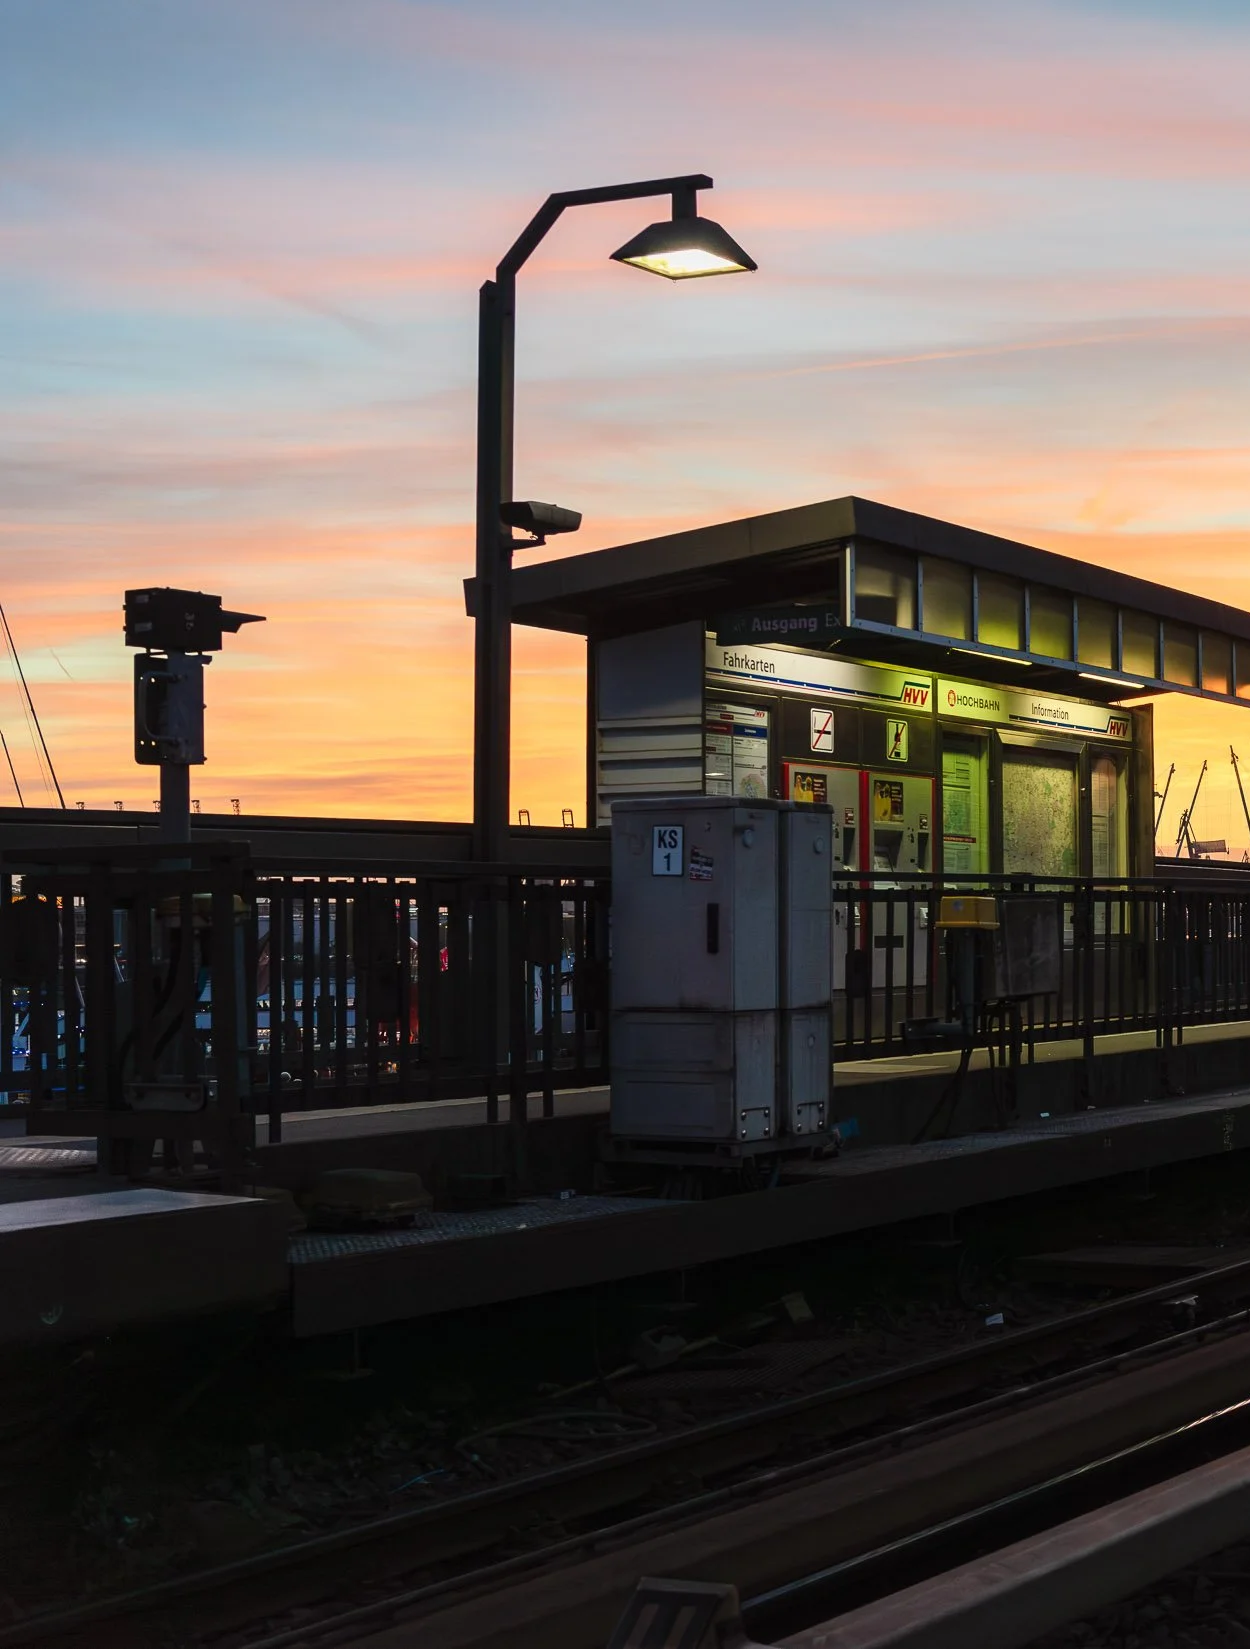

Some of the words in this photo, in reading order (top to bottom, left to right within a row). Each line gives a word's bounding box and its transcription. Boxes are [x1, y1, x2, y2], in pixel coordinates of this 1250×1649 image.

[752, 617, 817, 633] Ausgang
[723, 651, 775, 674] Fahrkarten
[903, 687, 928, 705] HVV
[957, 694, 1000, 711] HOCHBAHN
[1031, 702, 1069, 720] Information
[1109, 721, 1128, 737] HVV
[657, 829, 678, 849] KS
[663, 852, 671, 872] 1
